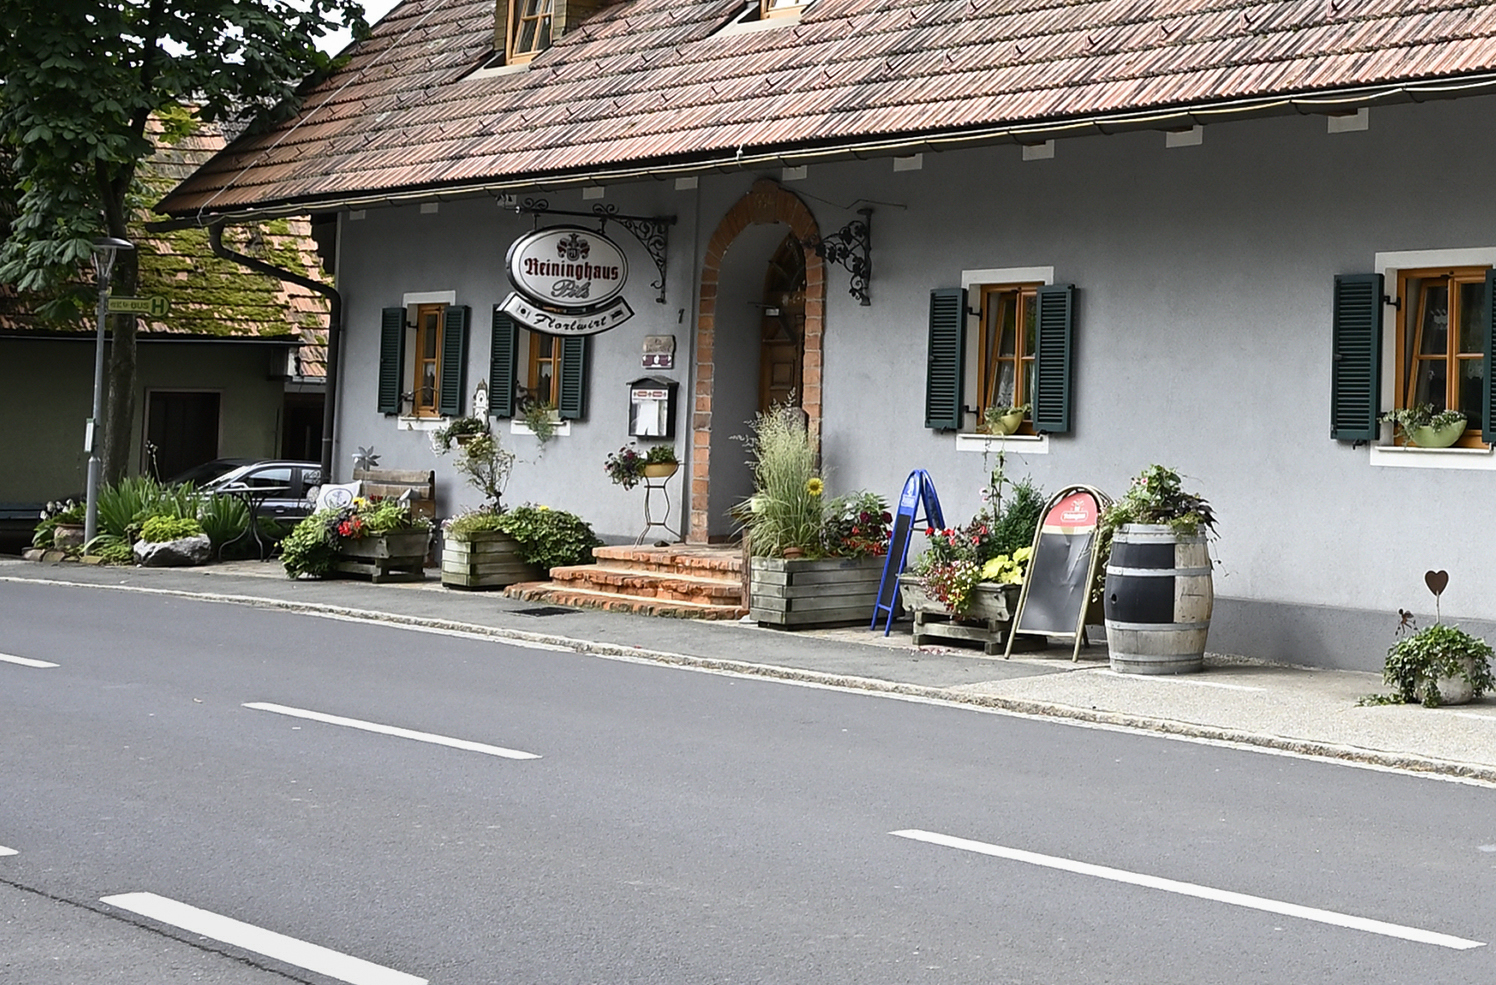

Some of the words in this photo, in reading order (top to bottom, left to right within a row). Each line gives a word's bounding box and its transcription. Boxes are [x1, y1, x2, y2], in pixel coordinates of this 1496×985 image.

[524, 257, 619, 281] Reininghaus
[551, 279, 591, 299] Pils
[152, 299, 164, 313] H
[534, 313, 607, 331] Florlwirt
